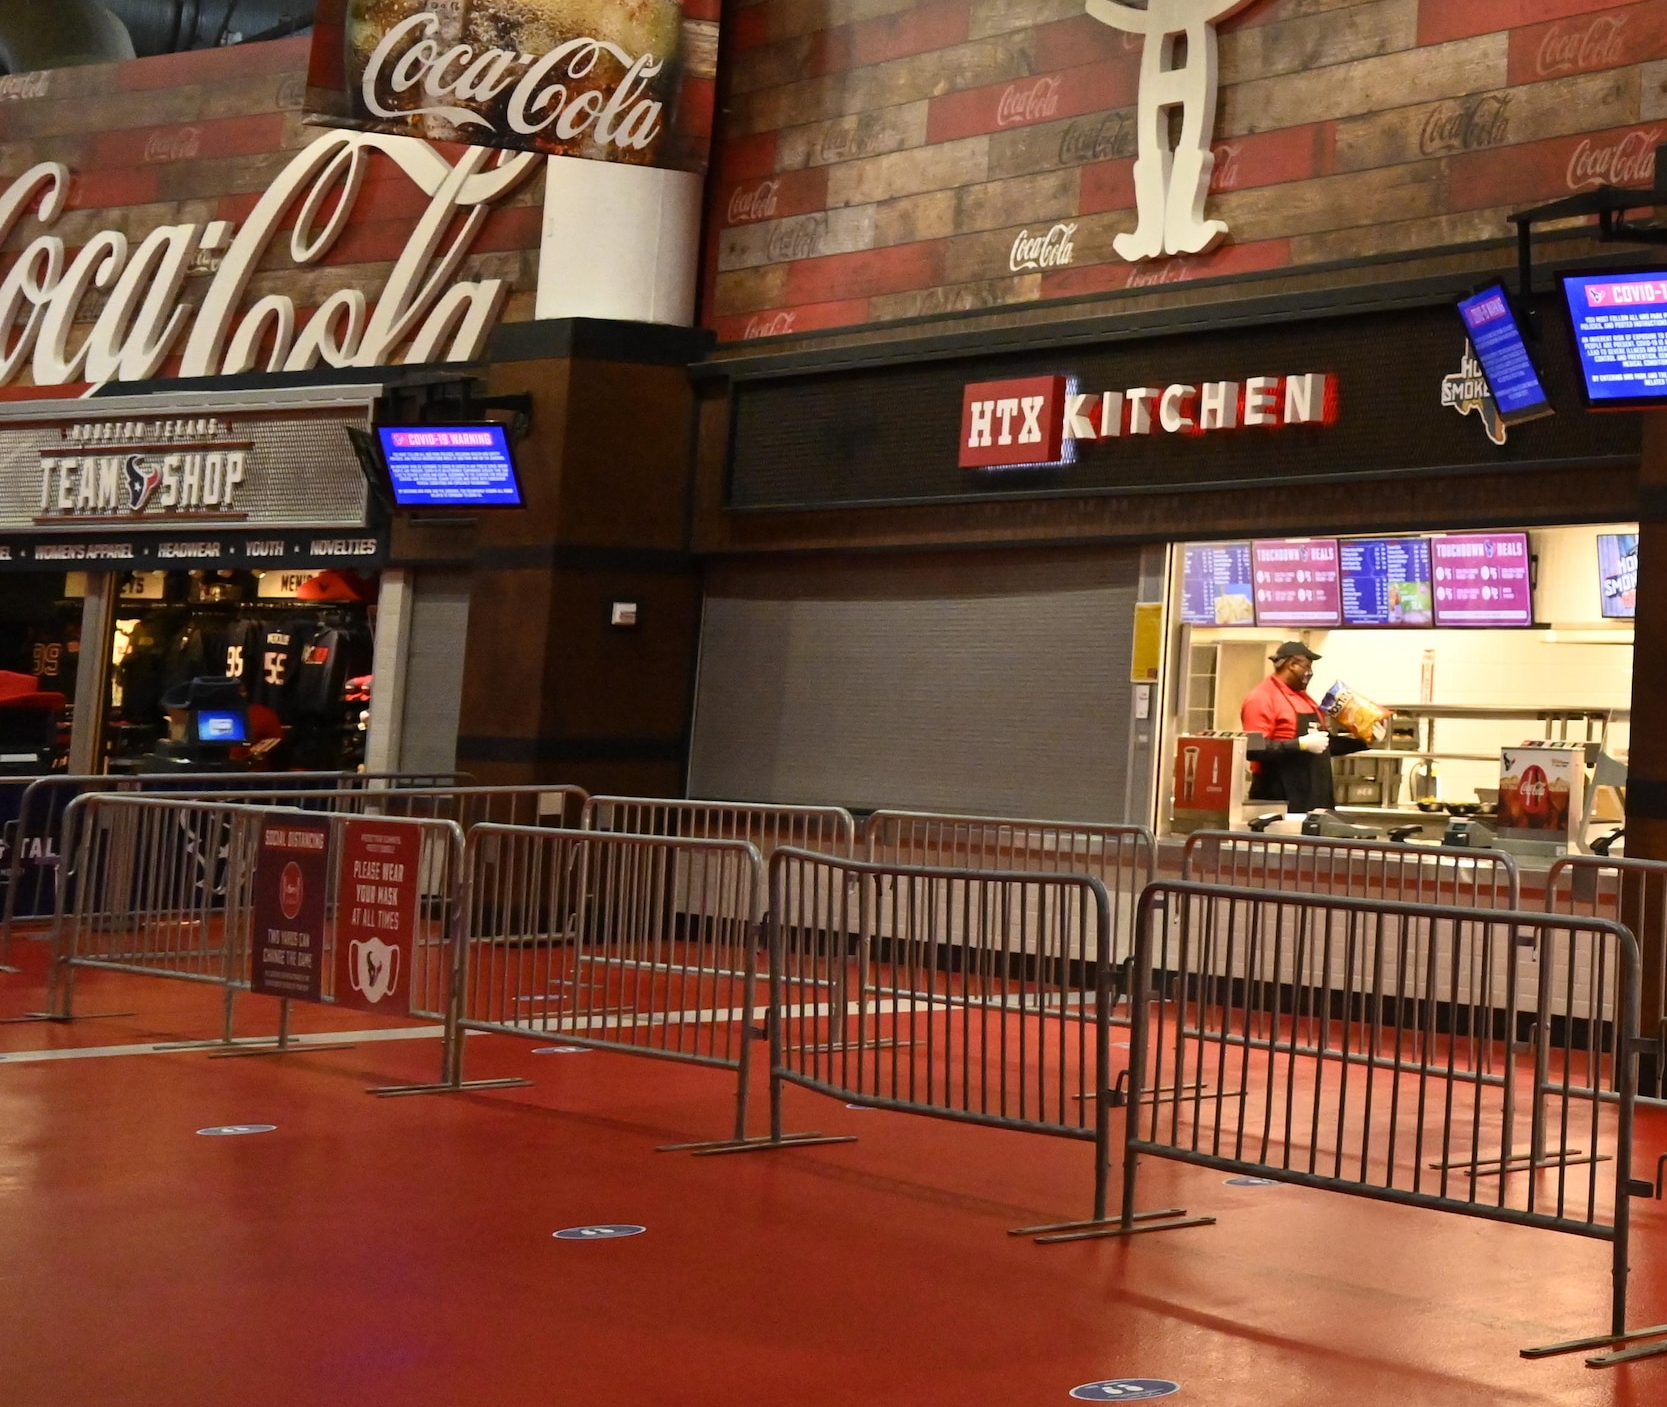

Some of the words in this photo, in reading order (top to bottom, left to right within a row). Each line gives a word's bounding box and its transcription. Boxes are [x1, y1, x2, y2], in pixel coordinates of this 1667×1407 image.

[361, 12, 664, 149] Coca-Cola
[1009, 222, 1077, 272] Coca-Cola
[968, 396, 1044, 448] HTX
[1062, 373, 1325, 440] KITCHEN
[408, 434, 449, 445] COVID-19
[451, 433, 491, 445] WARNING
[41, 456, 120, 511] TEAM
[161, 452, 245, 507] SHOP
[158, 542, 221, 558] HEADWEAR
[246, 541, 284, 556] YOUTH
[310, 539, 377, 555] NOVELTIES
[354, 861, 380, 880] PLEASE
[382, 863, 404, 882] WEAR
[357, 885, 375, 903] YOUR
[378, 886, 398, 906] MASK
[352, 908, 362, 925] AT
[363, 910, 375, 927] ALL
[378, 911, 399, 930] TIMES
